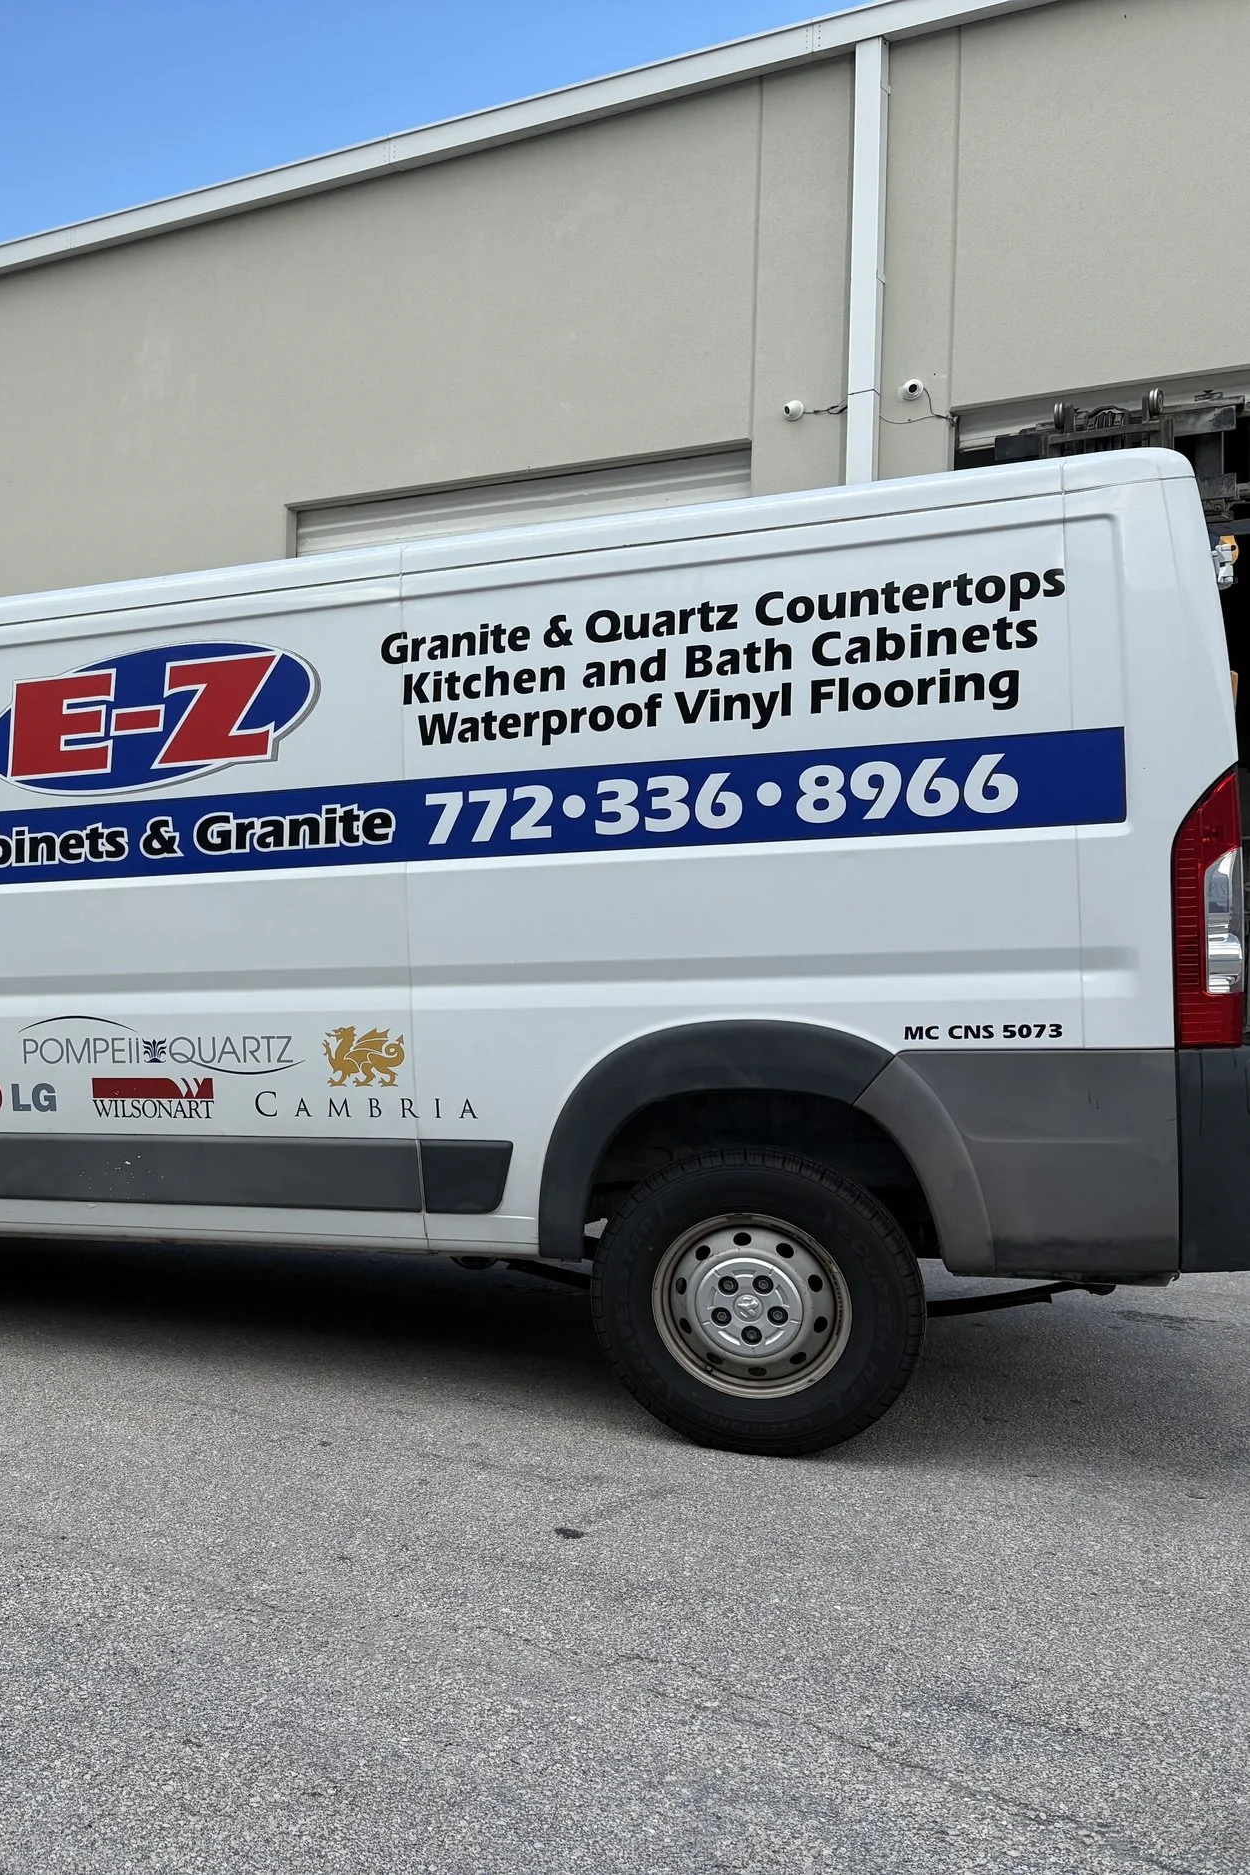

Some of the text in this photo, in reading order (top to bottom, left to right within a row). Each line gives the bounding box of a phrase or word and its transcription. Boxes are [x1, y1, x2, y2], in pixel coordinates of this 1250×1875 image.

[381, 568, 1066, 664] Granite & Quartz Countertops
[403, 617, 1038, 705] Kitchen and Bath Cabinets
[9, 651, 281, 779] E-Z
[418, 668, 1019, 745] Waterproof Vinyl Flooring
[142, 816, 183, 858] &
[193, 803, 395, 856] Granite
[169, 1036, 295, 1066] QUARTZ
[904, 1024, 1063, 1040] MC CNS 5073
[11, 1082, 57, 1112] LG
[92, 1099, 214, 1119] WILSONART
[254, 1091, 478, 1119] CAMBRIA
